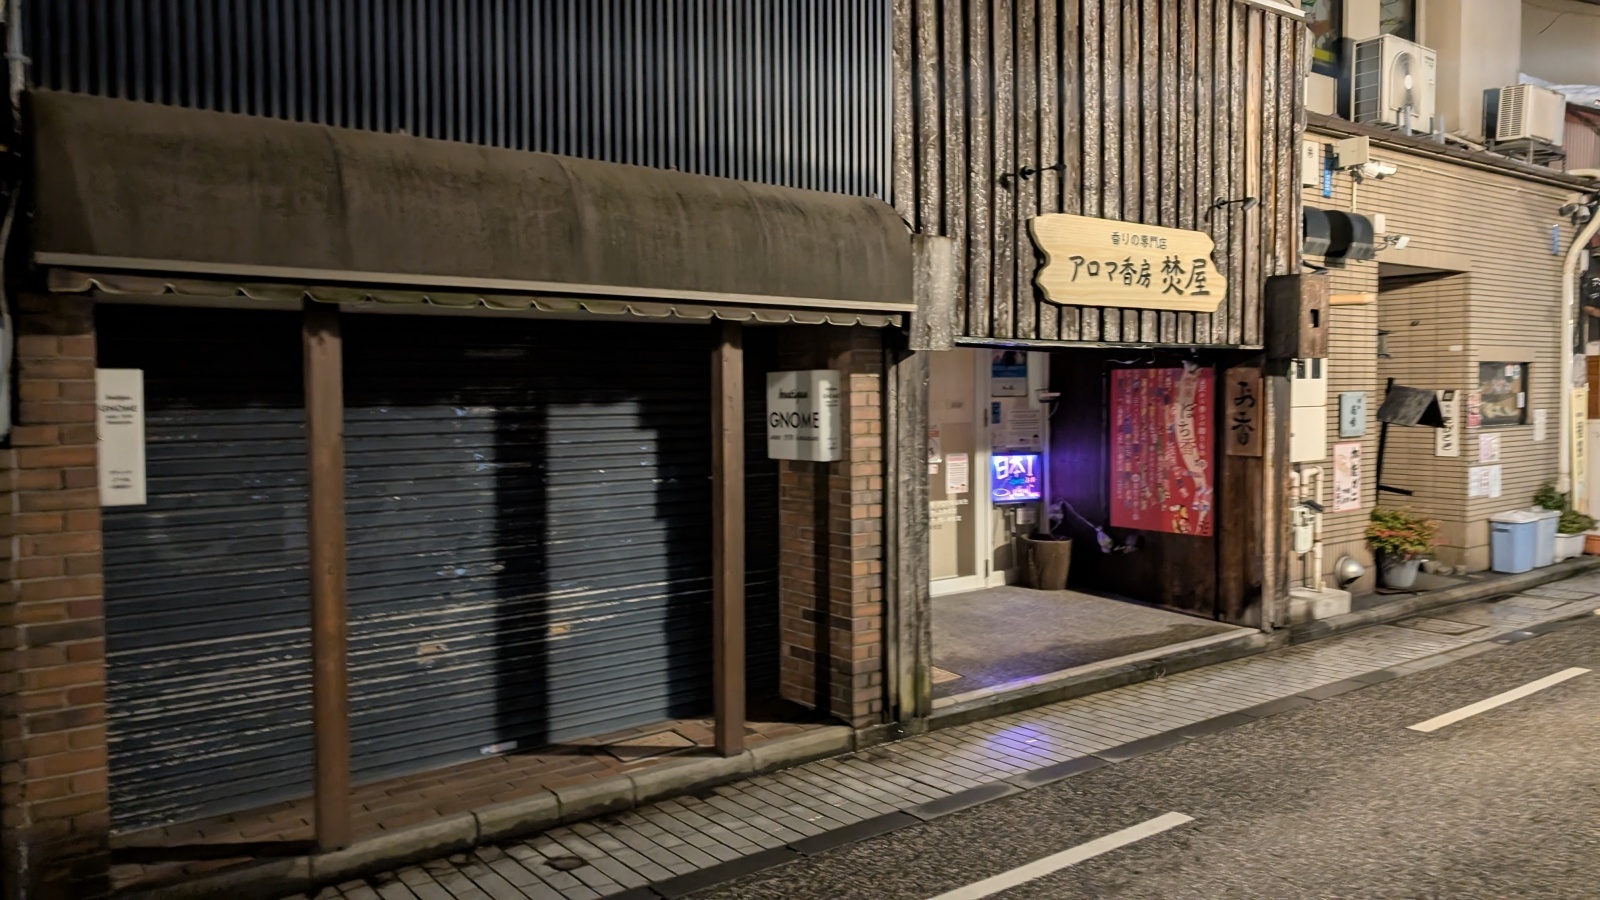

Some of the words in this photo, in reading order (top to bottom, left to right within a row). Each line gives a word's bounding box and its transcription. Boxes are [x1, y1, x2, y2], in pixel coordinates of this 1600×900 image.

[1110, 231, 1168, 250] 香りの専門店
[1069, 255, 1151, 289] アロマ香房
[1161, 255, 1211, 296] 焚屋
[769, 411, 819, 429] GNOME
